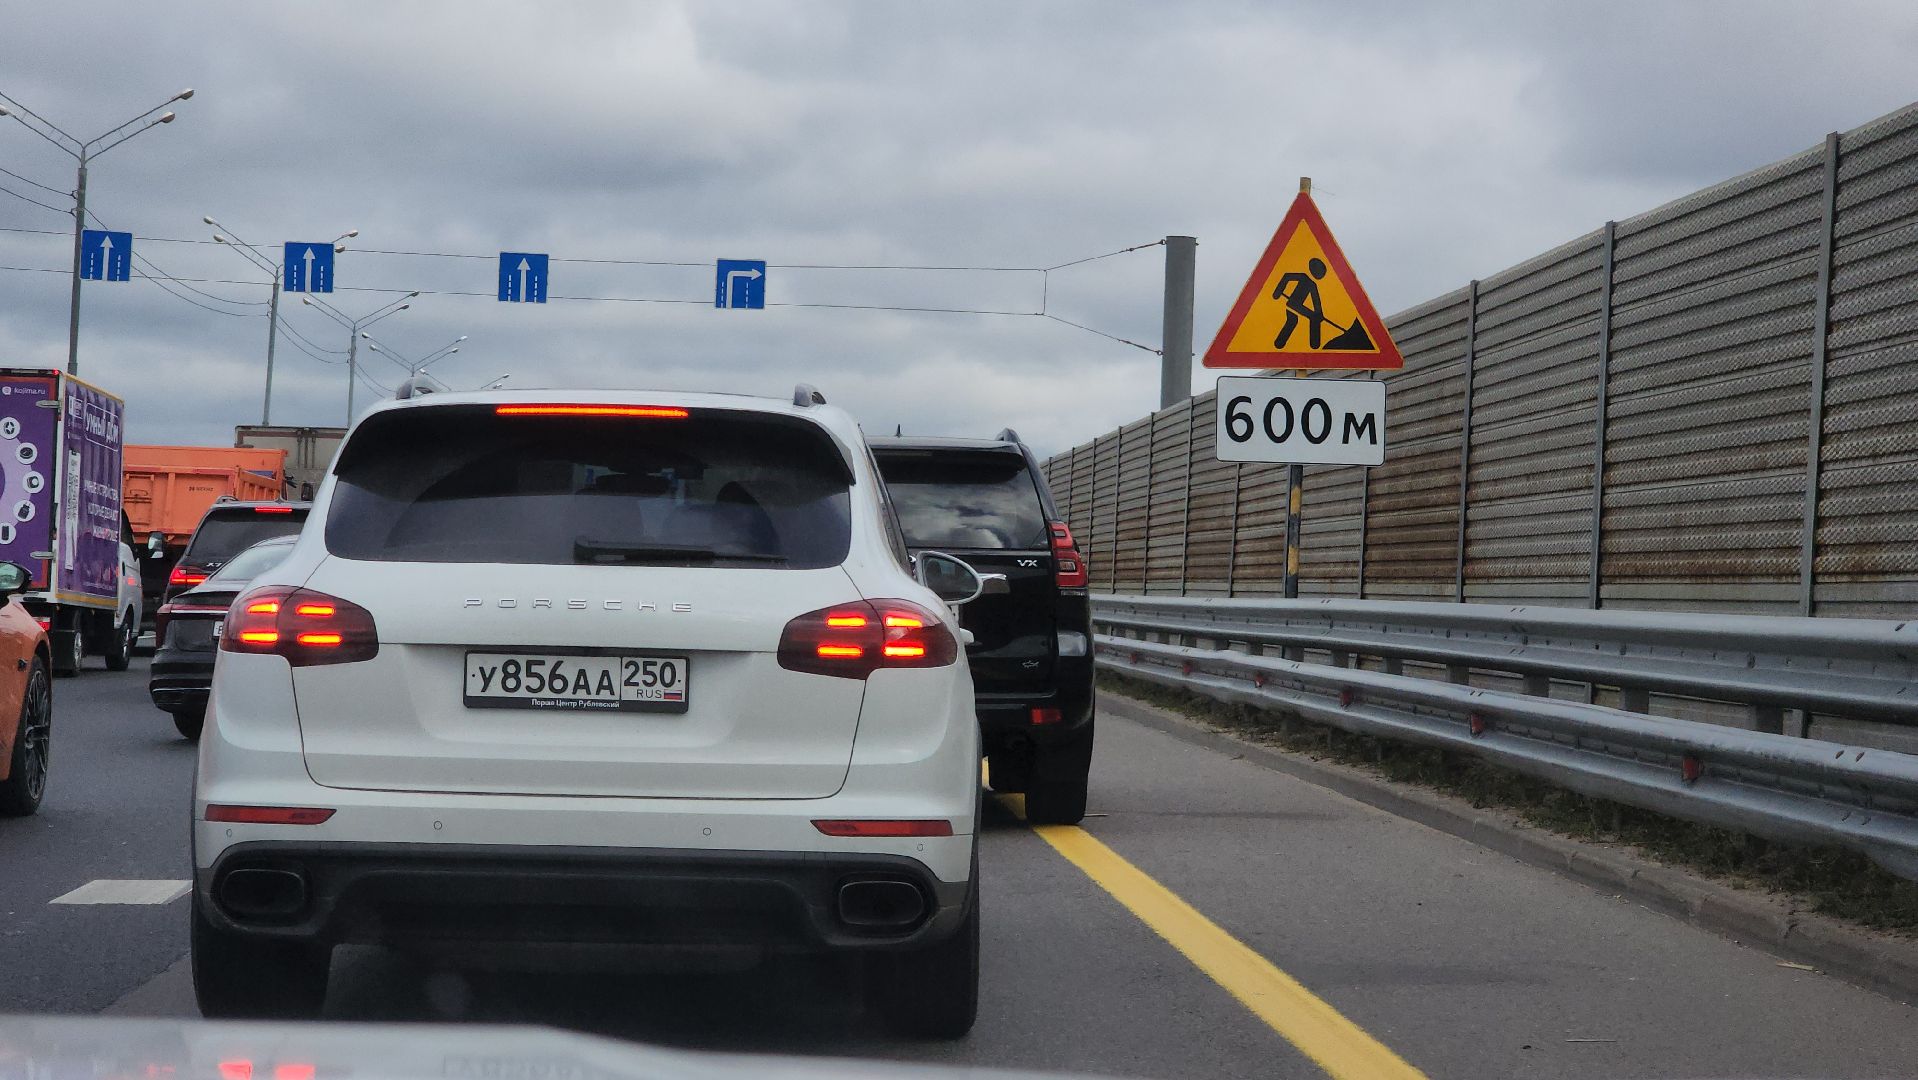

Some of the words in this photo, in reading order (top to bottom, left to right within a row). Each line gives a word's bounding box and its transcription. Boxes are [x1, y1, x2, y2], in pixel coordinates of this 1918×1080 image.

[14, 386, 46, 395] kojima.ru
[1016, 559, 1038, 567] VX
[463, 598, 692, 612] PORSCHE
[623, 660, 677, 688] 250
[636, 688, 662, 699] RUS
[531, 698, 555, 708] Порше
[556, 699, 578, 709] Центр
